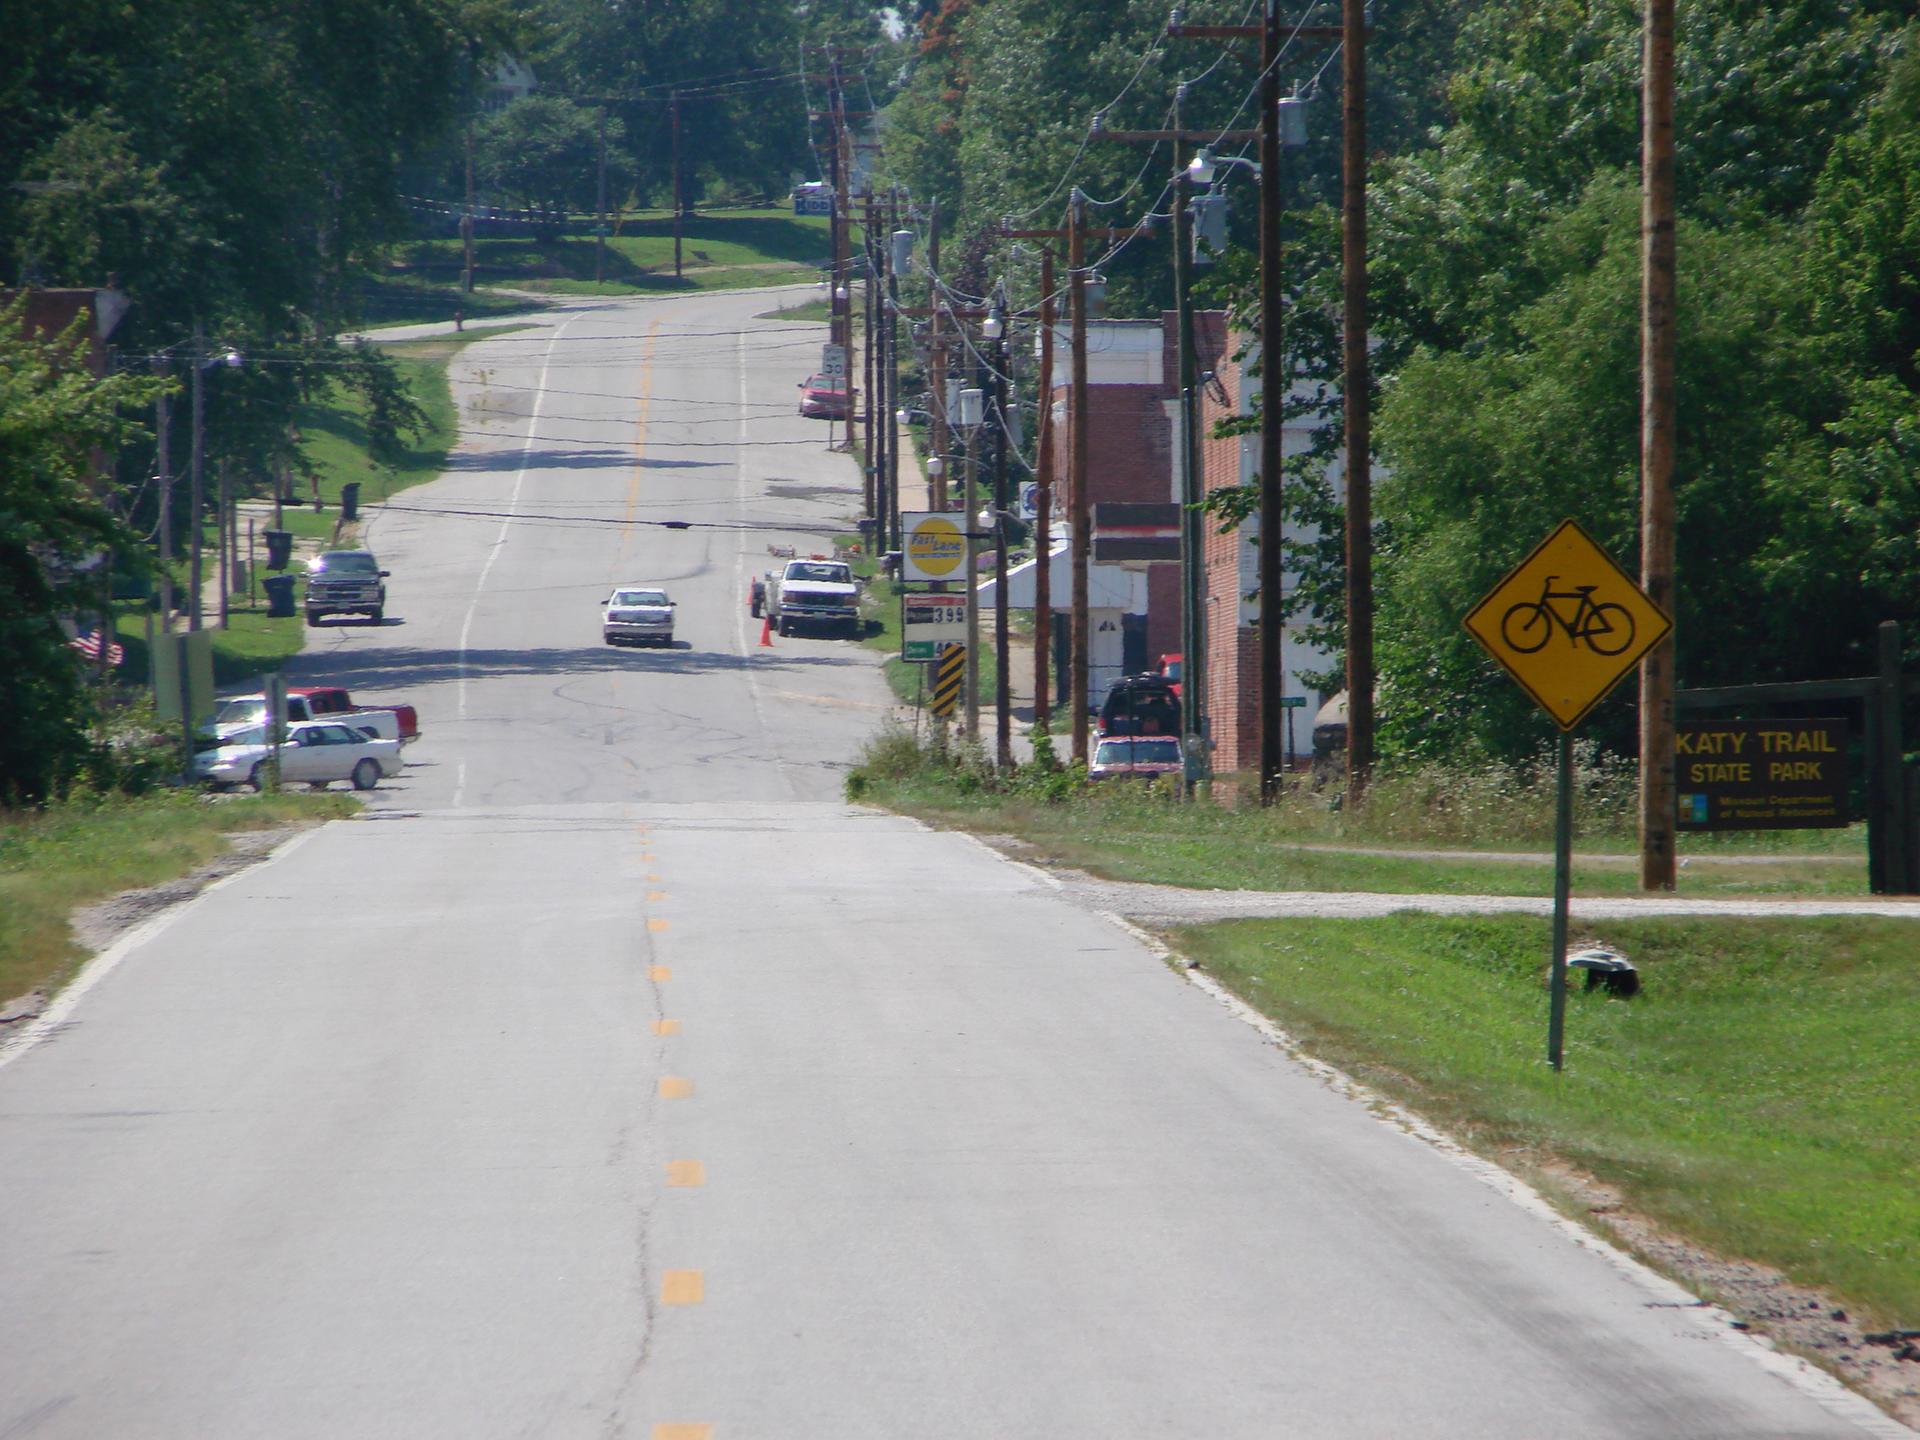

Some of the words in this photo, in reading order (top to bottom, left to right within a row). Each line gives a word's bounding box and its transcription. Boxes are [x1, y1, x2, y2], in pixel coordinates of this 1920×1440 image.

[826, 364, 842, 374] 30
[1675, 731, 1747, 754] KATY
[1758, 730, 1837, 753] TRAIL
[1690, 763, 1752, 783] STATE
[1770, 762, 1823, 782] PARK
